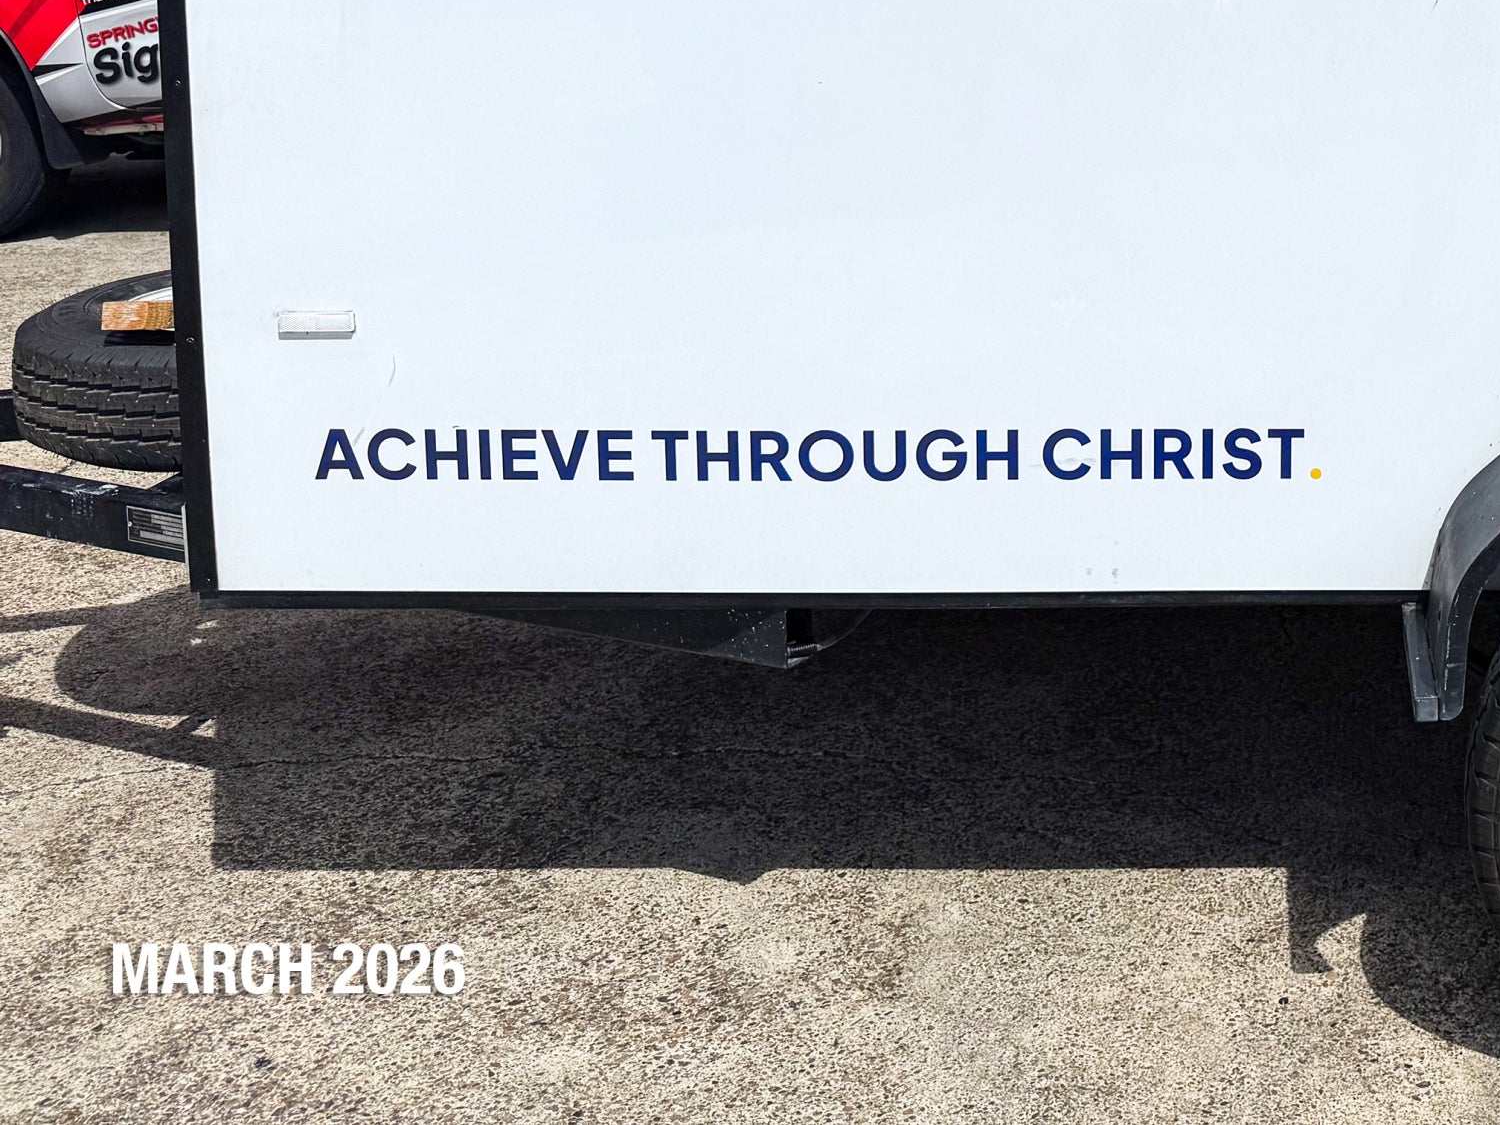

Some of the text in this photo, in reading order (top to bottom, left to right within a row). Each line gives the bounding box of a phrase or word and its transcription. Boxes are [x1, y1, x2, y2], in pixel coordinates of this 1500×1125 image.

[86, 17, 159, 49] SPRING
[315, 428, 1322, 481] ACHIEVE THROUGH CHRIST.
